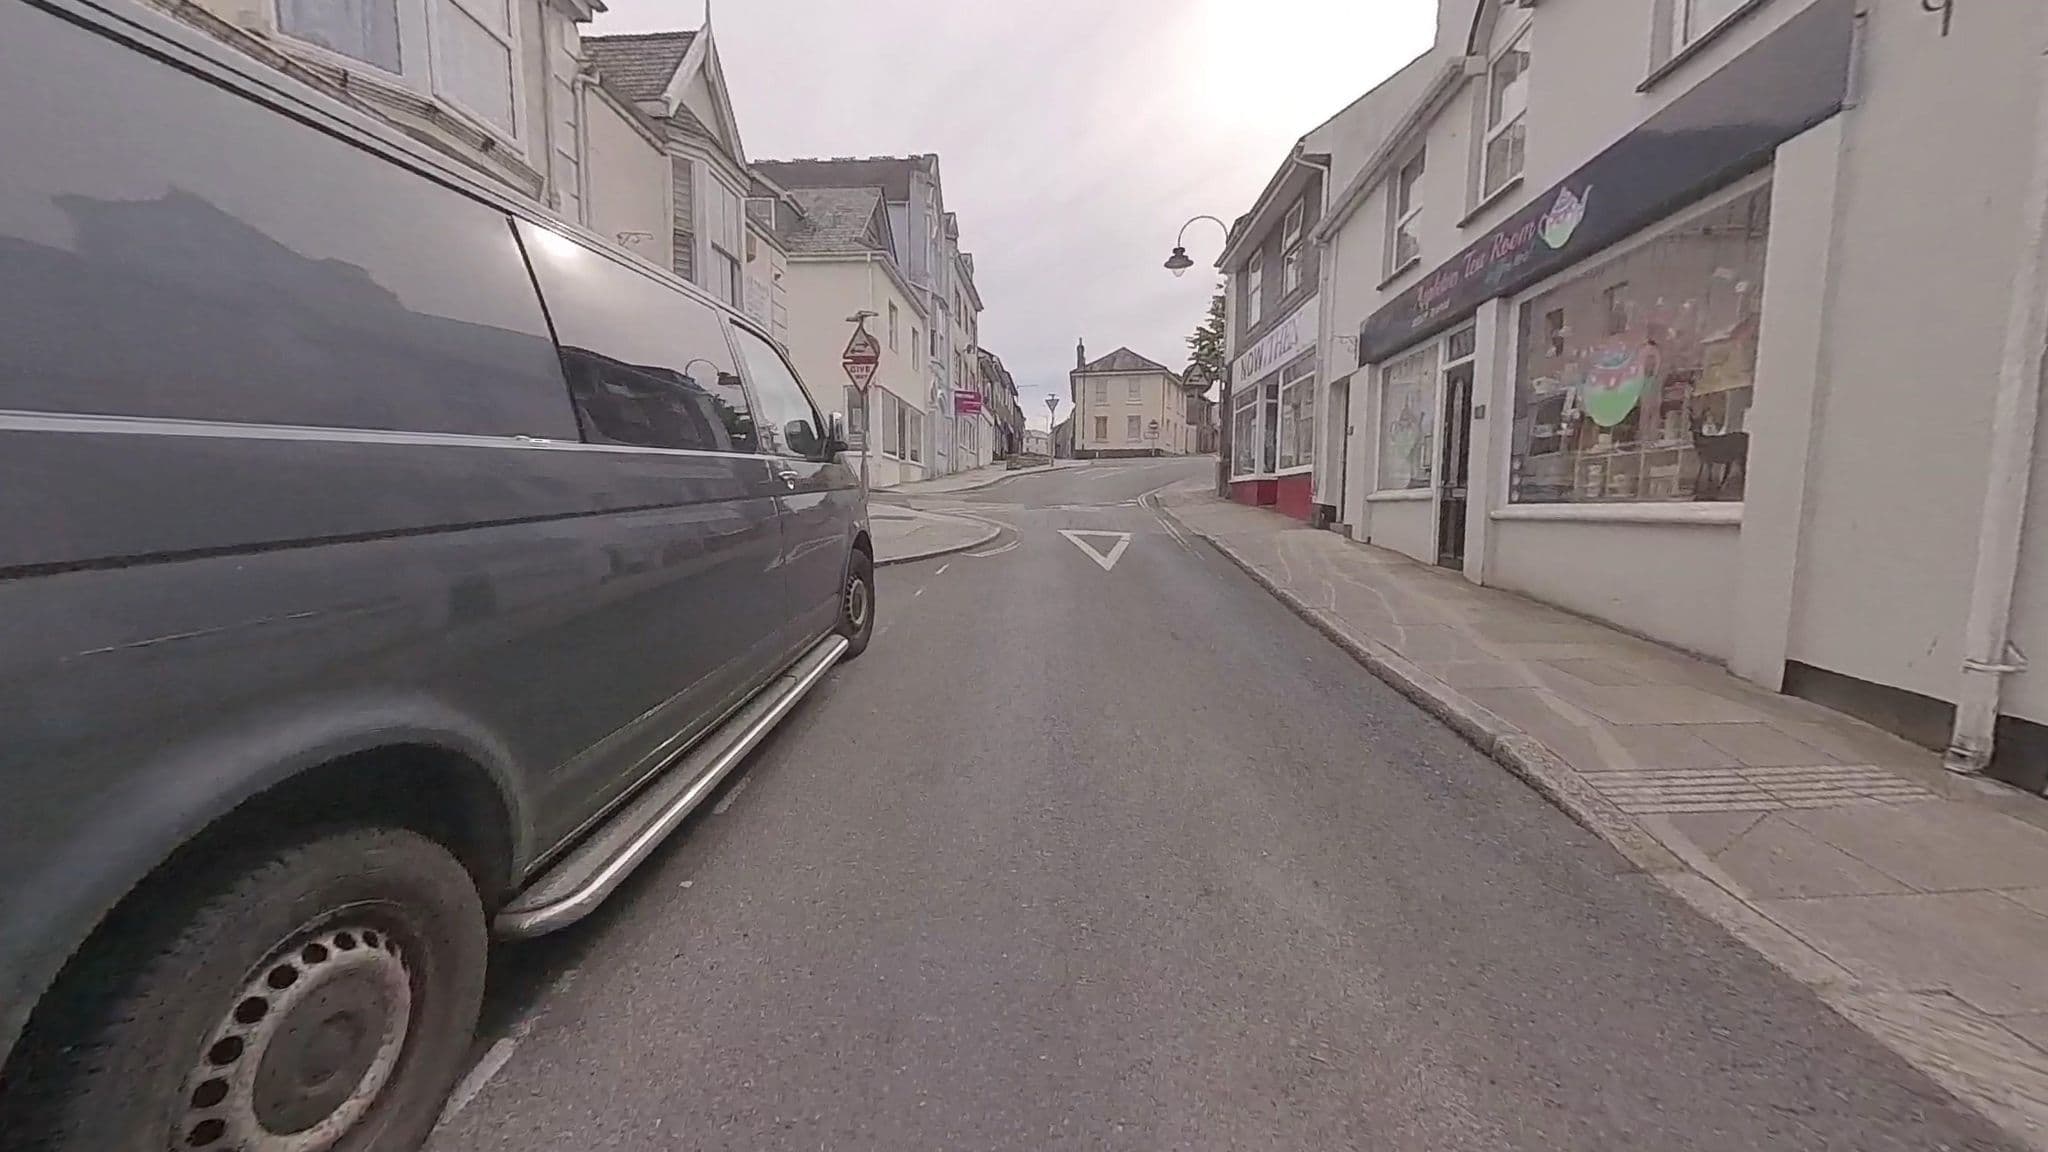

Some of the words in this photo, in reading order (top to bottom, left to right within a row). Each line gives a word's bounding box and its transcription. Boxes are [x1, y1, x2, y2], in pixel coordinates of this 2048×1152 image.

[1464, 250, 1487, 279] Tea
[1490, 220, 1537, 263] Room
[850, 365, 871, 374] GIVE
